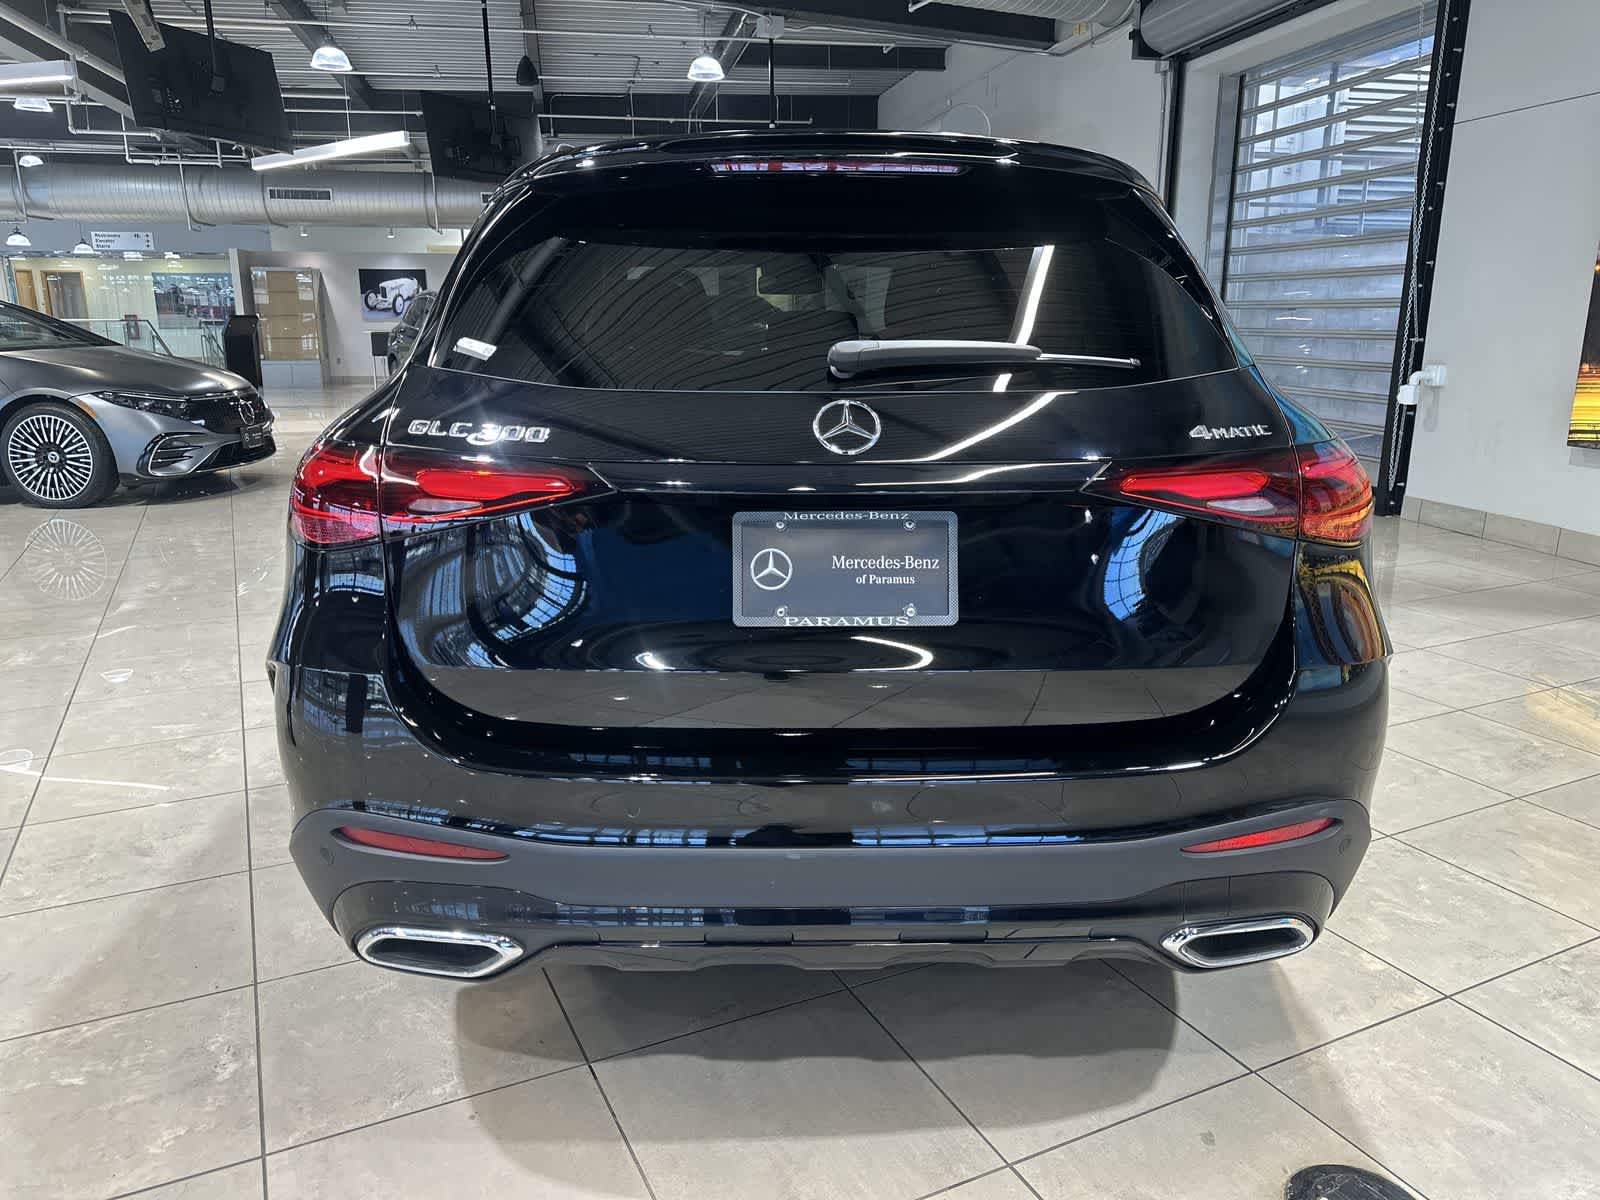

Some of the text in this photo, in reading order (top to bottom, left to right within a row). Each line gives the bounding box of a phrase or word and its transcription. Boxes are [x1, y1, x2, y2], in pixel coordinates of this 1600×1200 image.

[1189, 424, 1273, 440] 4MATIC
[784, 511, 910, 520] Mercedes-Benz
[832, 555, 940, 570] Mercedes-Benz
[855, 574, 916, 585] of Paramus
[784, 616, 910, 627] PARAMUS
